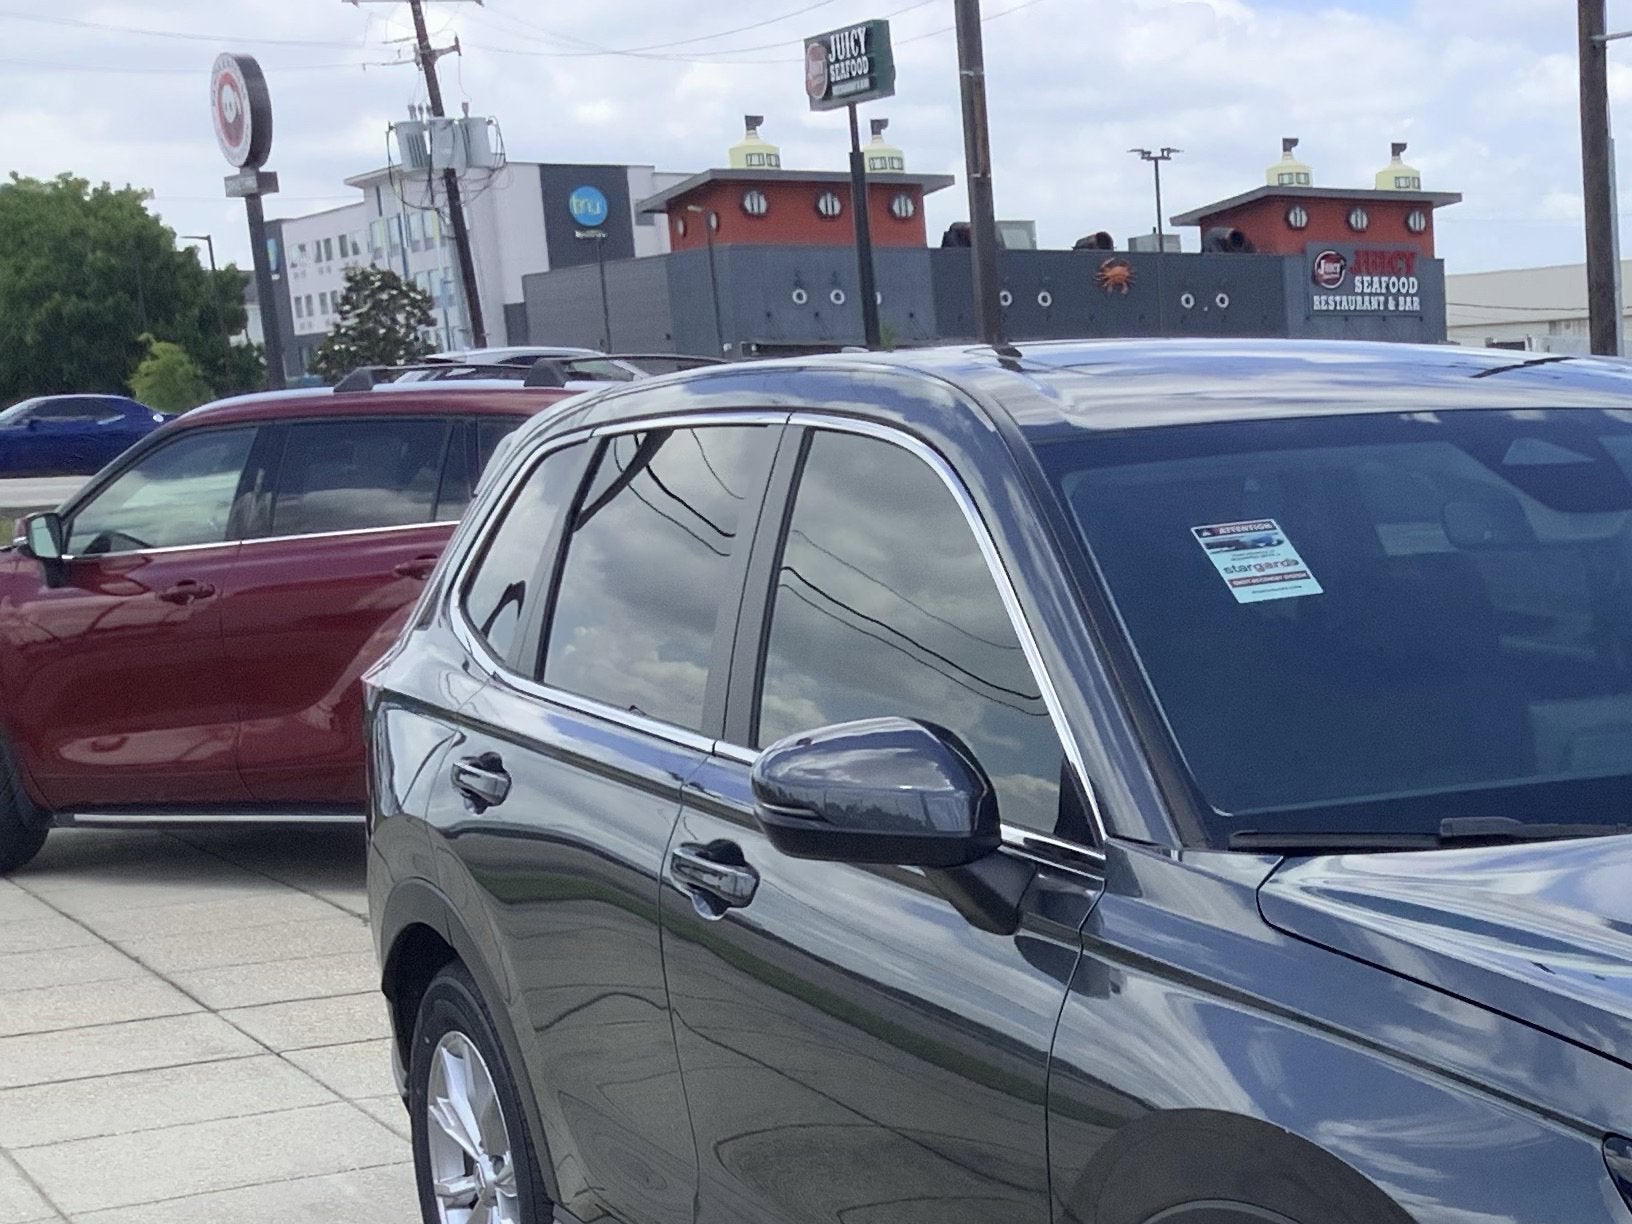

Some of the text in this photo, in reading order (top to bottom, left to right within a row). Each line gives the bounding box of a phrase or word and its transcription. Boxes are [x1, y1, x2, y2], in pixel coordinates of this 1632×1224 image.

[828, 26, 866, 62] JUICY
[829, 55, 869, 82] SEAFOOD
[1354, 276, 1418, 294] SEAFOOD
[1313, 295, 1385, 311] RESTAURANT
[1398, 296, 1420, 312] BAR
